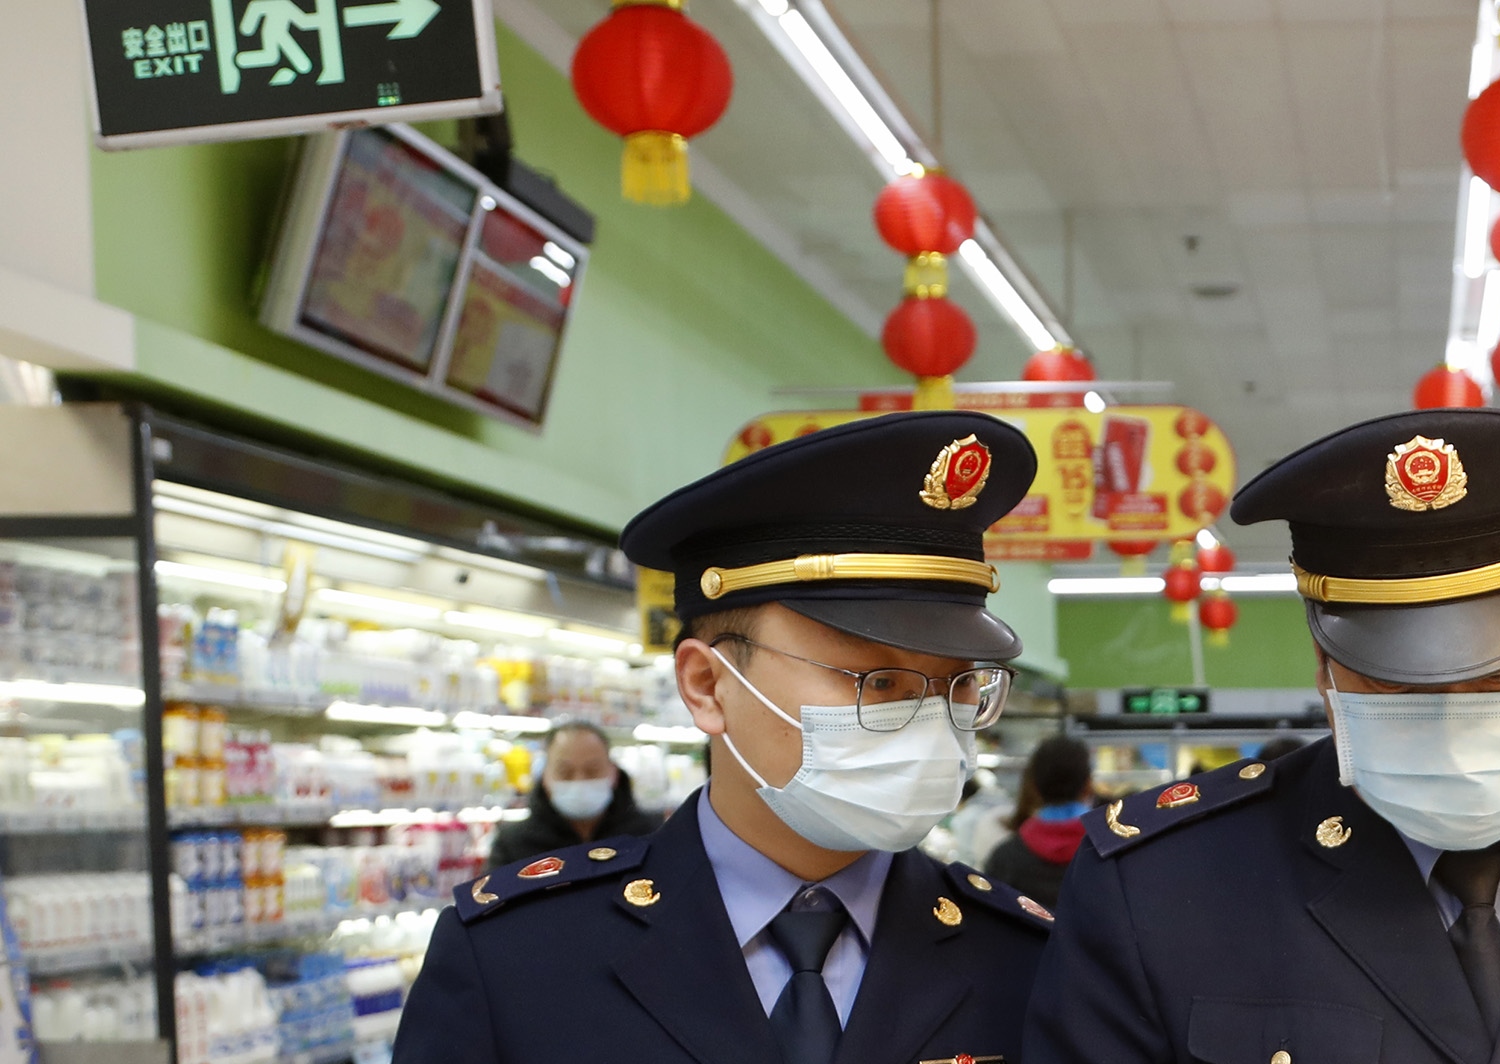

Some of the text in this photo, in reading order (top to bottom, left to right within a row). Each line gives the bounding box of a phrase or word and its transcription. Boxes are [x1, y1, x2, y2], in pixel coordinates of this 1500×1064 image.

[122, 20, 211, 59] 安全出口
[134, 53, 203, 79] EXIT
